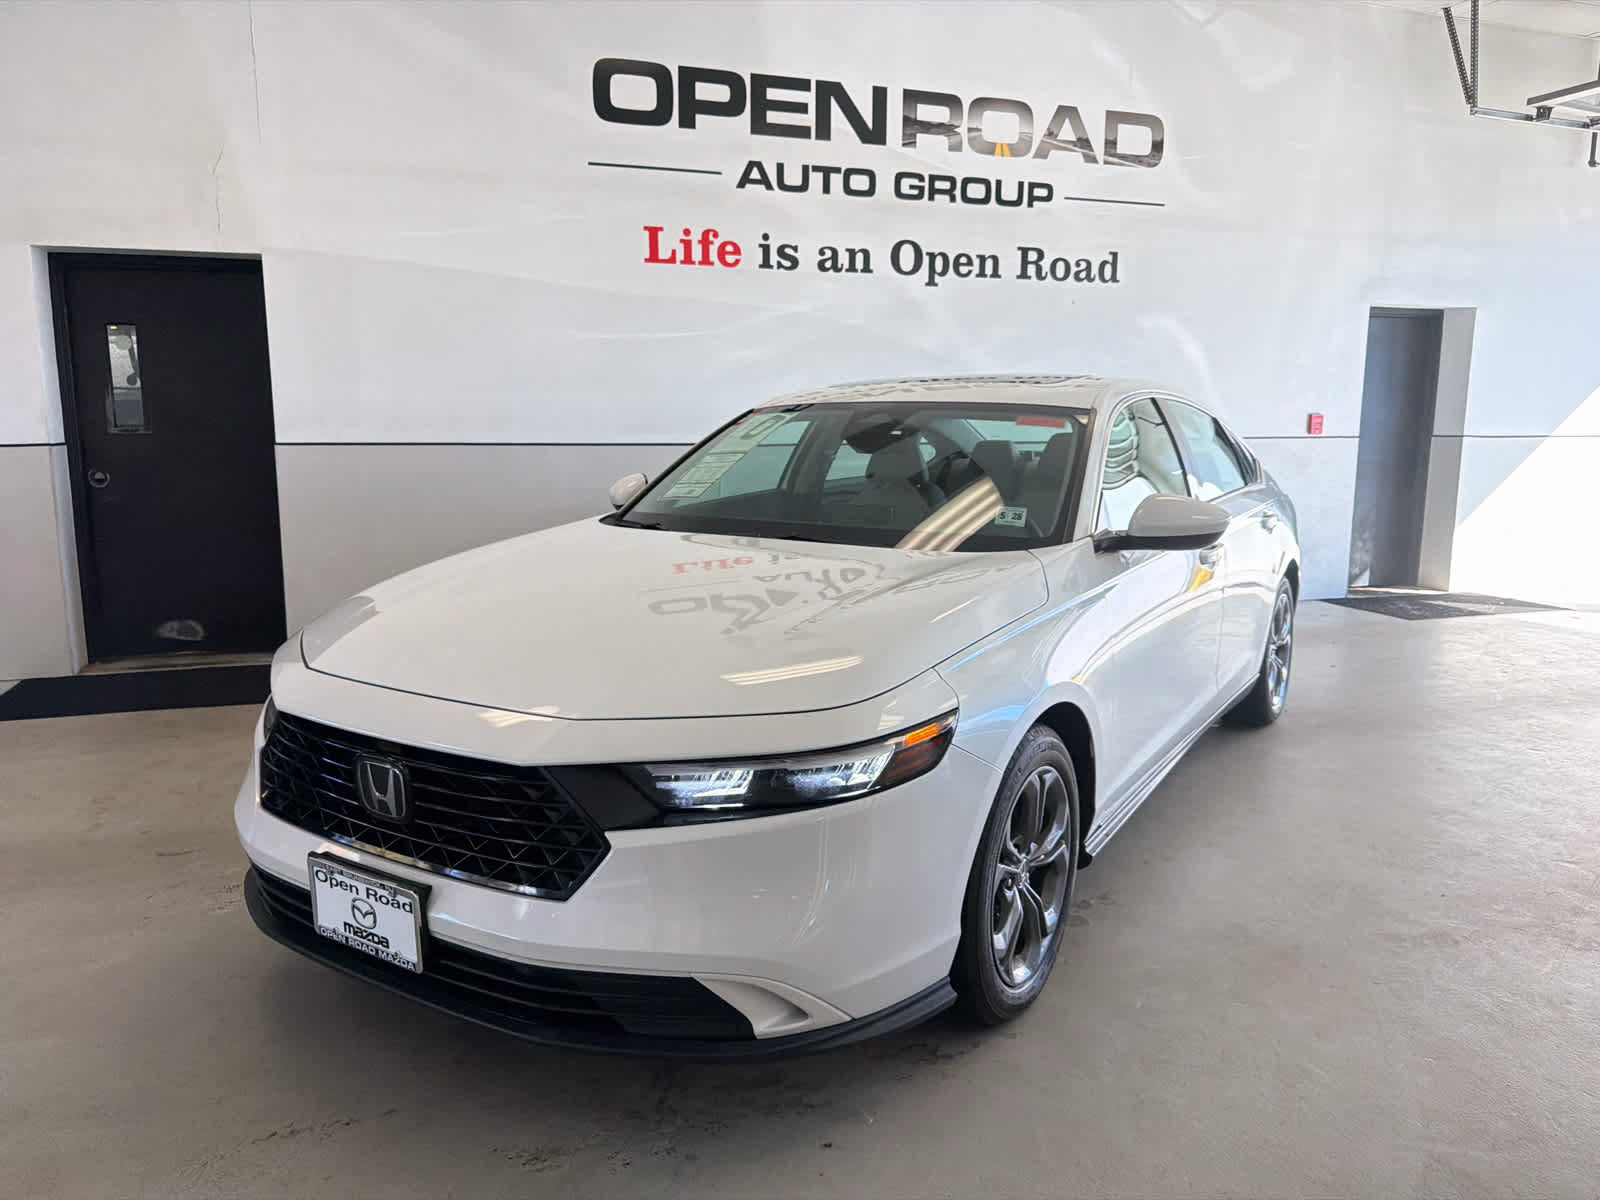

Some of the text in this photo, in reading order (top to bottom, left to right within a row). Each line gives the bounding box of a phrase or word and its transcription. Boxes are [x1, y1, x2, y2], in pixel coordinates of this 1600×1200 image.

[592, 57, 1165, 169] OPEN ROAD
[735, 160, 1054, 209] AUTO GROUP
[642, 225, 1120, 287] Life is an Open Road
[315, 869, 360, 896] Open
[365, 886, 413, 914] Road
[343, 921, 390, 949] mazda
[348, 939, 376, 955] ROAD
